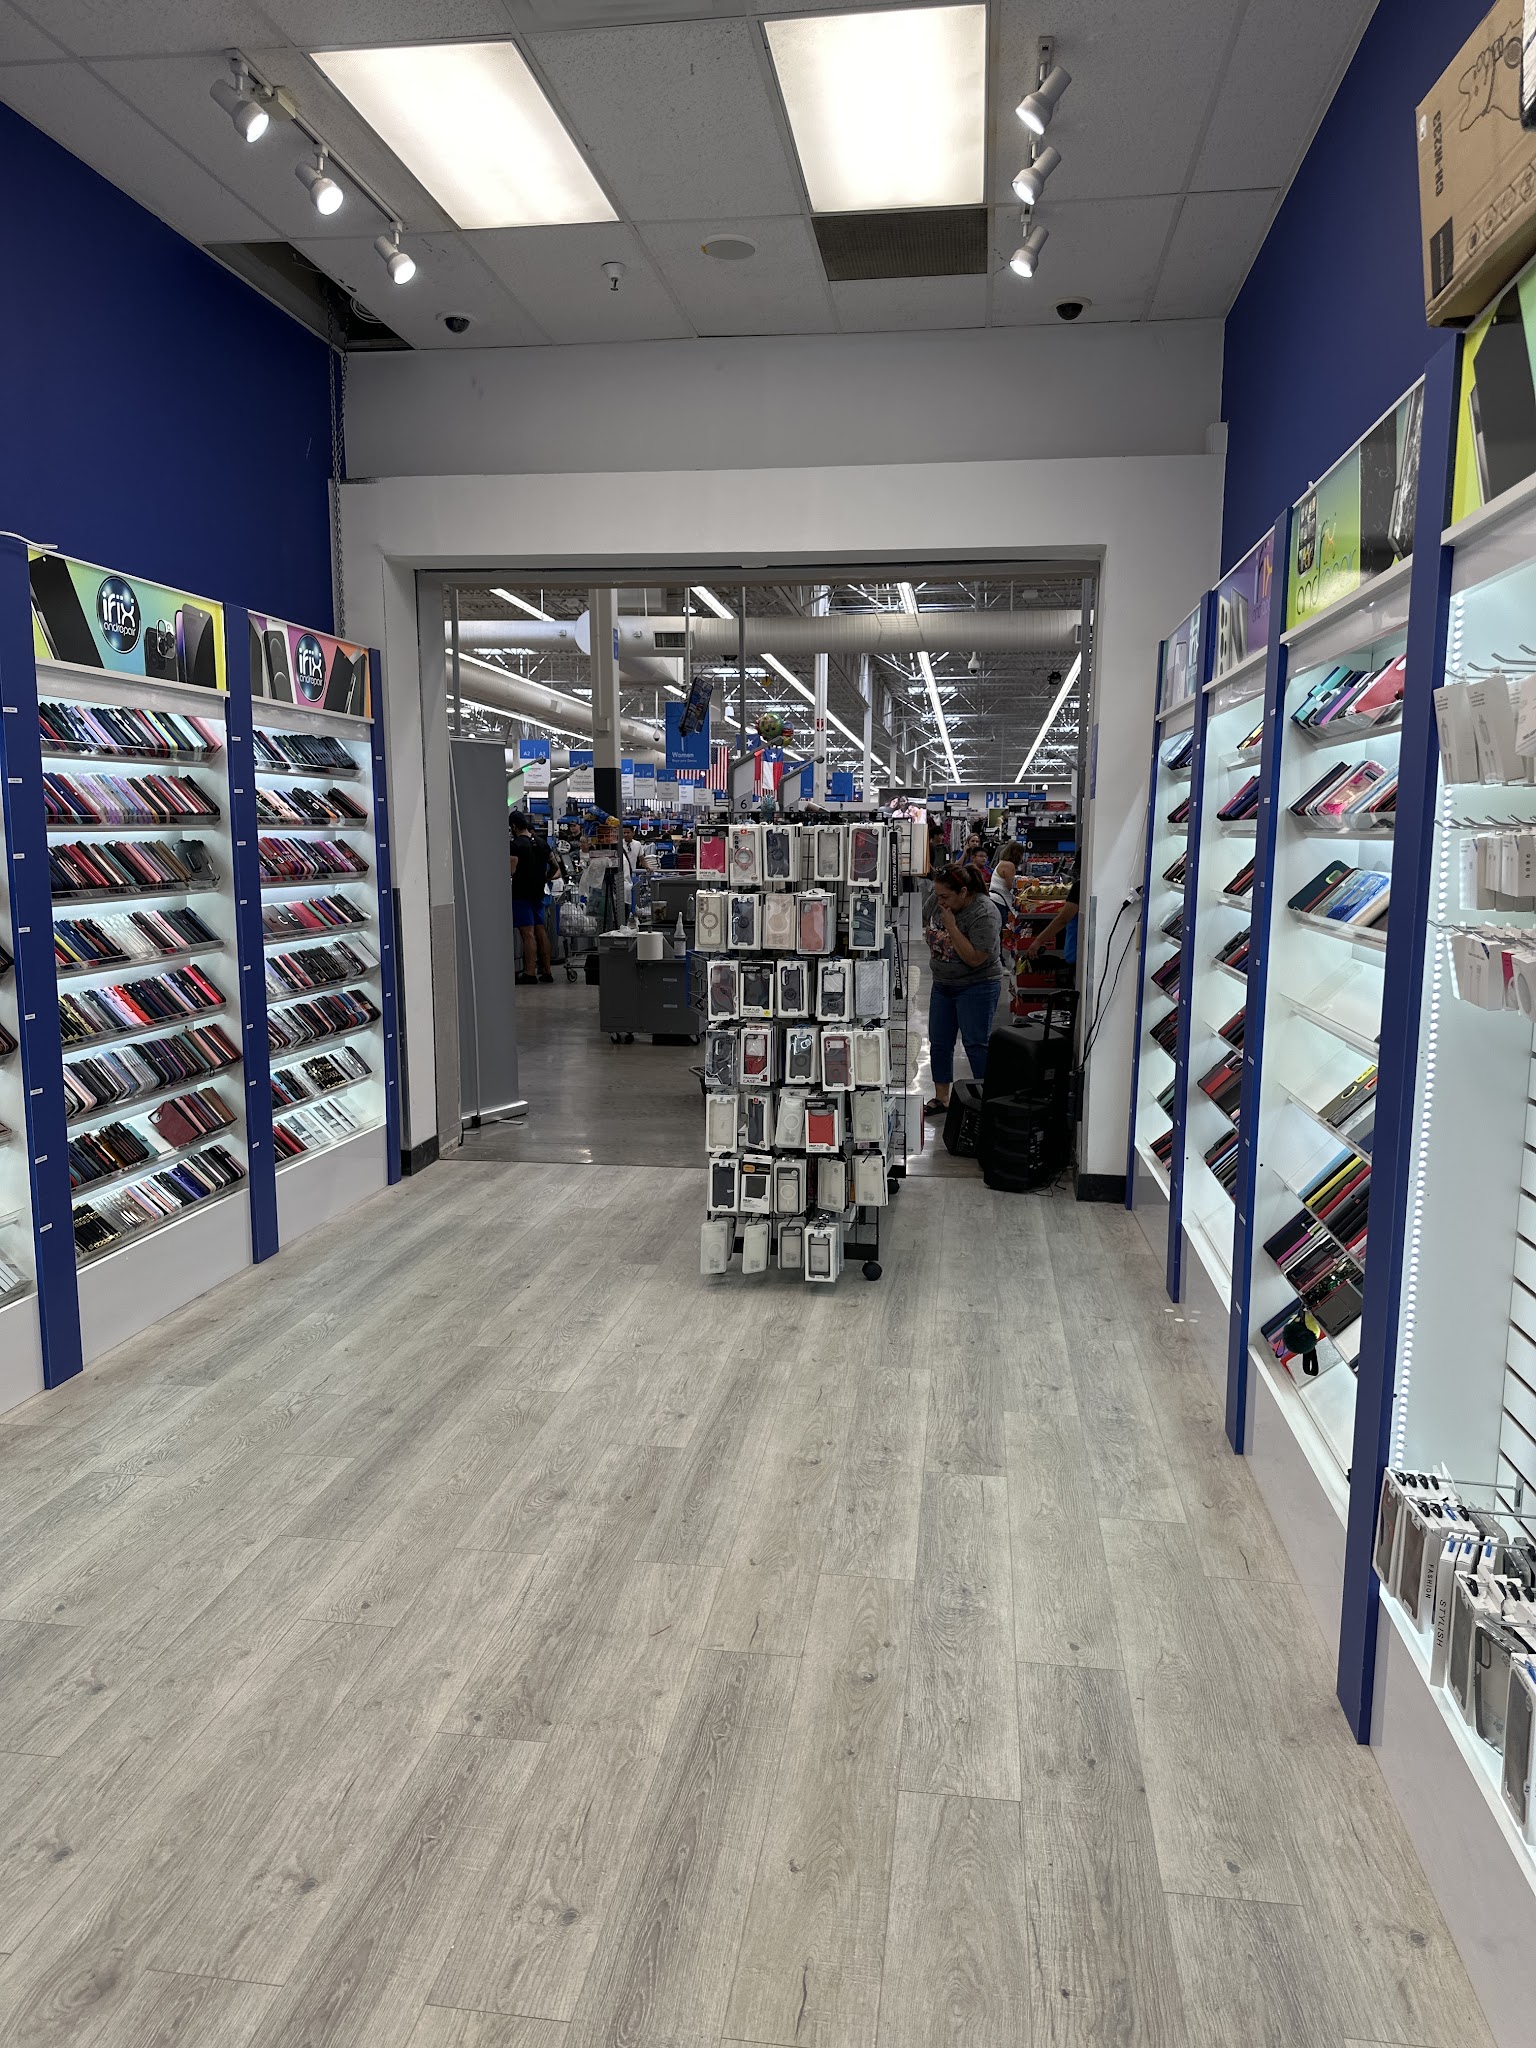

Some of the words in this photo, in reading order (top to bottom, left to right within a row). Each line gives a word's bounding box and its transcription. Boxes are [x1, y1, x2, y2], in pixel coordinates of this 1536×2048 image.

[740, 799, 748, 810] 6
[1425, 1563, 1435, 1599] FASHION
[1436, 1599, 1447, 1648] STYLISH
